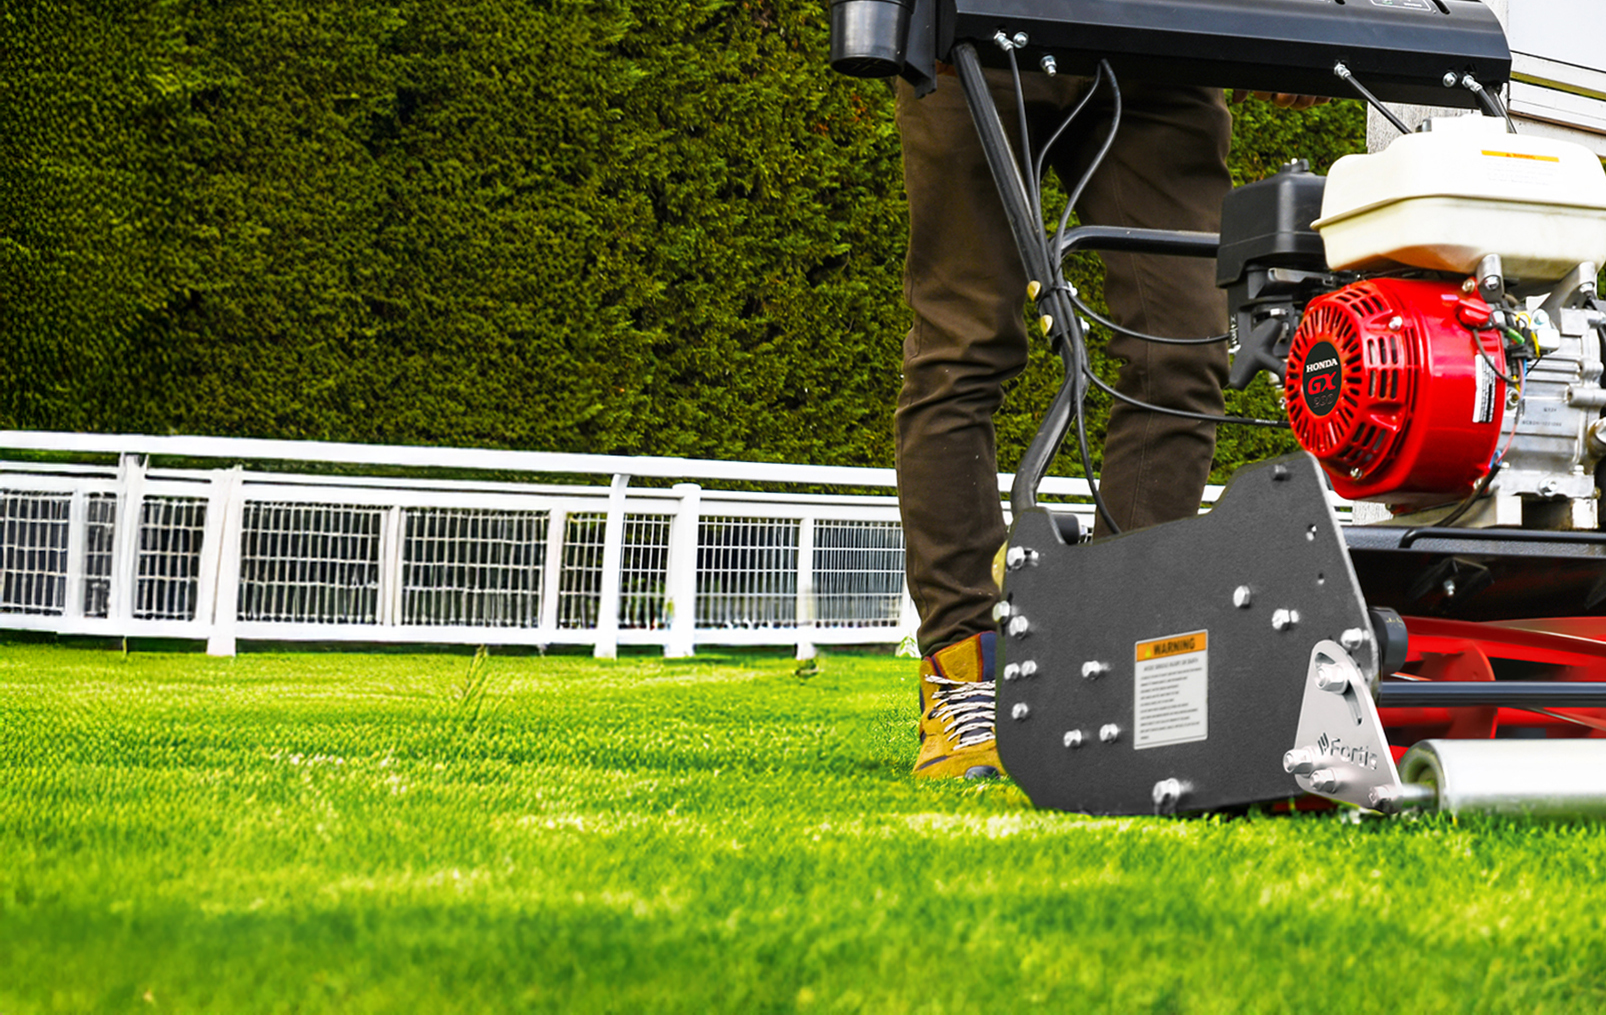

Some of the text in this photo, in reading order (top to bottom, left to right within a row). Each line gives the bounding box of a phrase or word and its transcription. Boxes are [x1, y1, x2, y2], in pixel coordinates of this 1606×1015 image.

[1306, 358, 1338, 373] HONDA
[1308, 371, 1336, 395] GX
[1153, 637, 1196, 656] WARNING
[1330, 738, 1378, 770] Fortis
